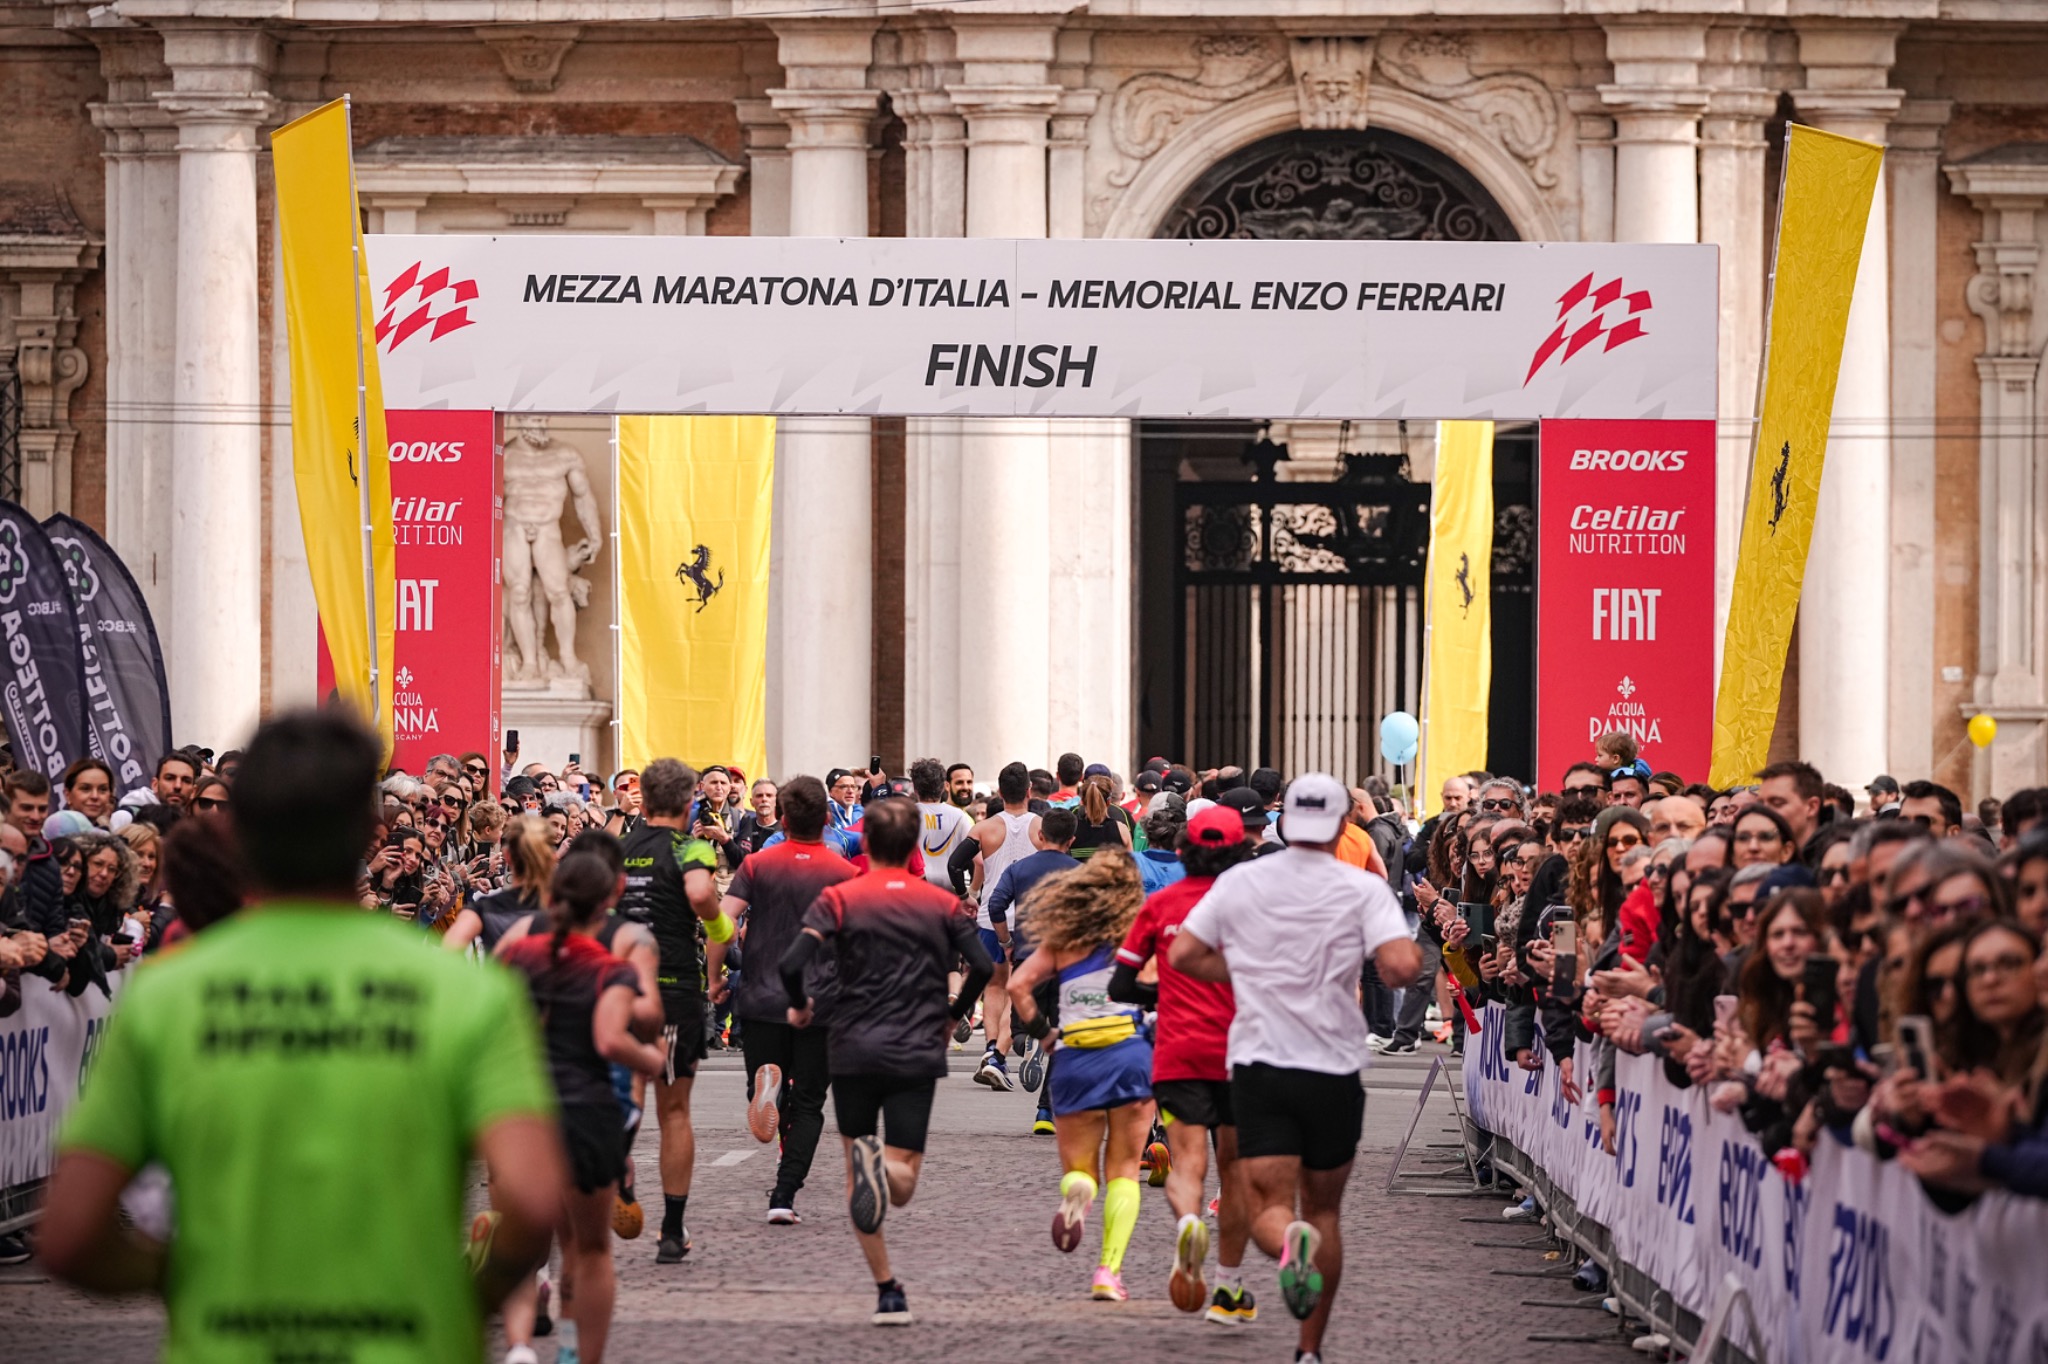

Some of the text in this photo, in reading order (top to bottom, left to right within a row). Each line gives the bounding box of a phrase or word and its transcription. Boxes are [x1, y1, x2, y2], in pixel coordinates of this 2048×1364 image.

[523, 274, 643, 304] MEZZA
[652, 275, 859, 306] MARATONA
[868, 277, 1010, 308] D'ITALIA
[1047, 279, 1241, 310] MEMORIAL
[1250, 281, 1348, 310] ENZO
[1356, 282, 1506, 312] FERRARI
[924, 343, 1099, 388] FINISH
[388, 441, 465, 462] OOKS
[1569, 449, 1688, 471] BROOKS
[392, 497, 463, 522] tilar
[1570, 505, 1686, 531] Cetilar
[393, 525, 463, 545] RITION
[1569, 533, 1686, 554] NUTRITION
[394, 579, 440, 631] AT
[1593, 588, 1662, 641] FIAT
[394, 692, 423, 706] CQUA
[1608, 702, 1646, 716] ACQUA
[394, 707, 440, 733] NNA
[925, 813, 943, 830] MT
[0, 1026, 49, 1122] ROOKS
